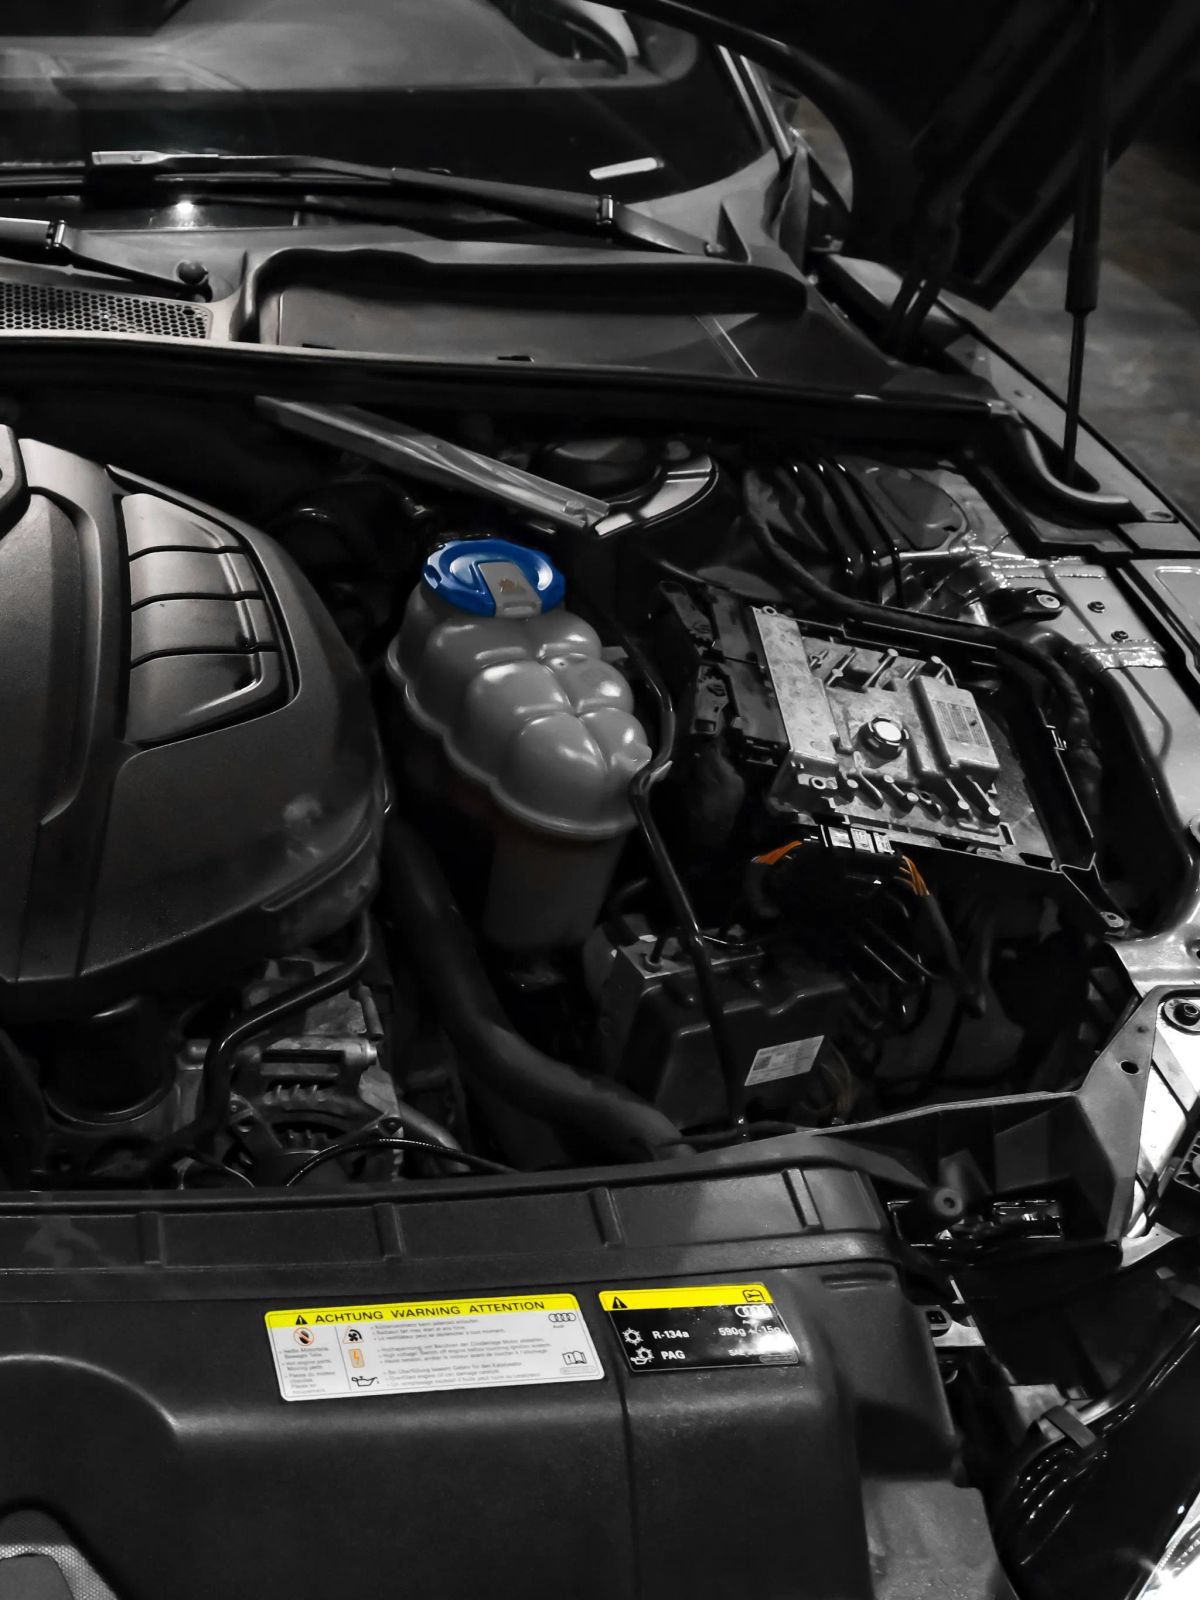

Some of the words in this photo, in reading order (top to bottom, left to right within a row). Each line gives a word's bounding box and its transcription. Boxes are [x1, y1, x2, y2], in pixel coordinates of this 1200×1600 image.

[315, 1311, 384, 1323] ACHTUNG
[391, 1306, 461, 1318] WARNING
[469, 1301, 545, 1313] ATTENTION
[651, 1329, 690, 1340] R-134a
[718, 1326, 747, 1337] 590g
[660, 1349, 686, 1360] PAG
